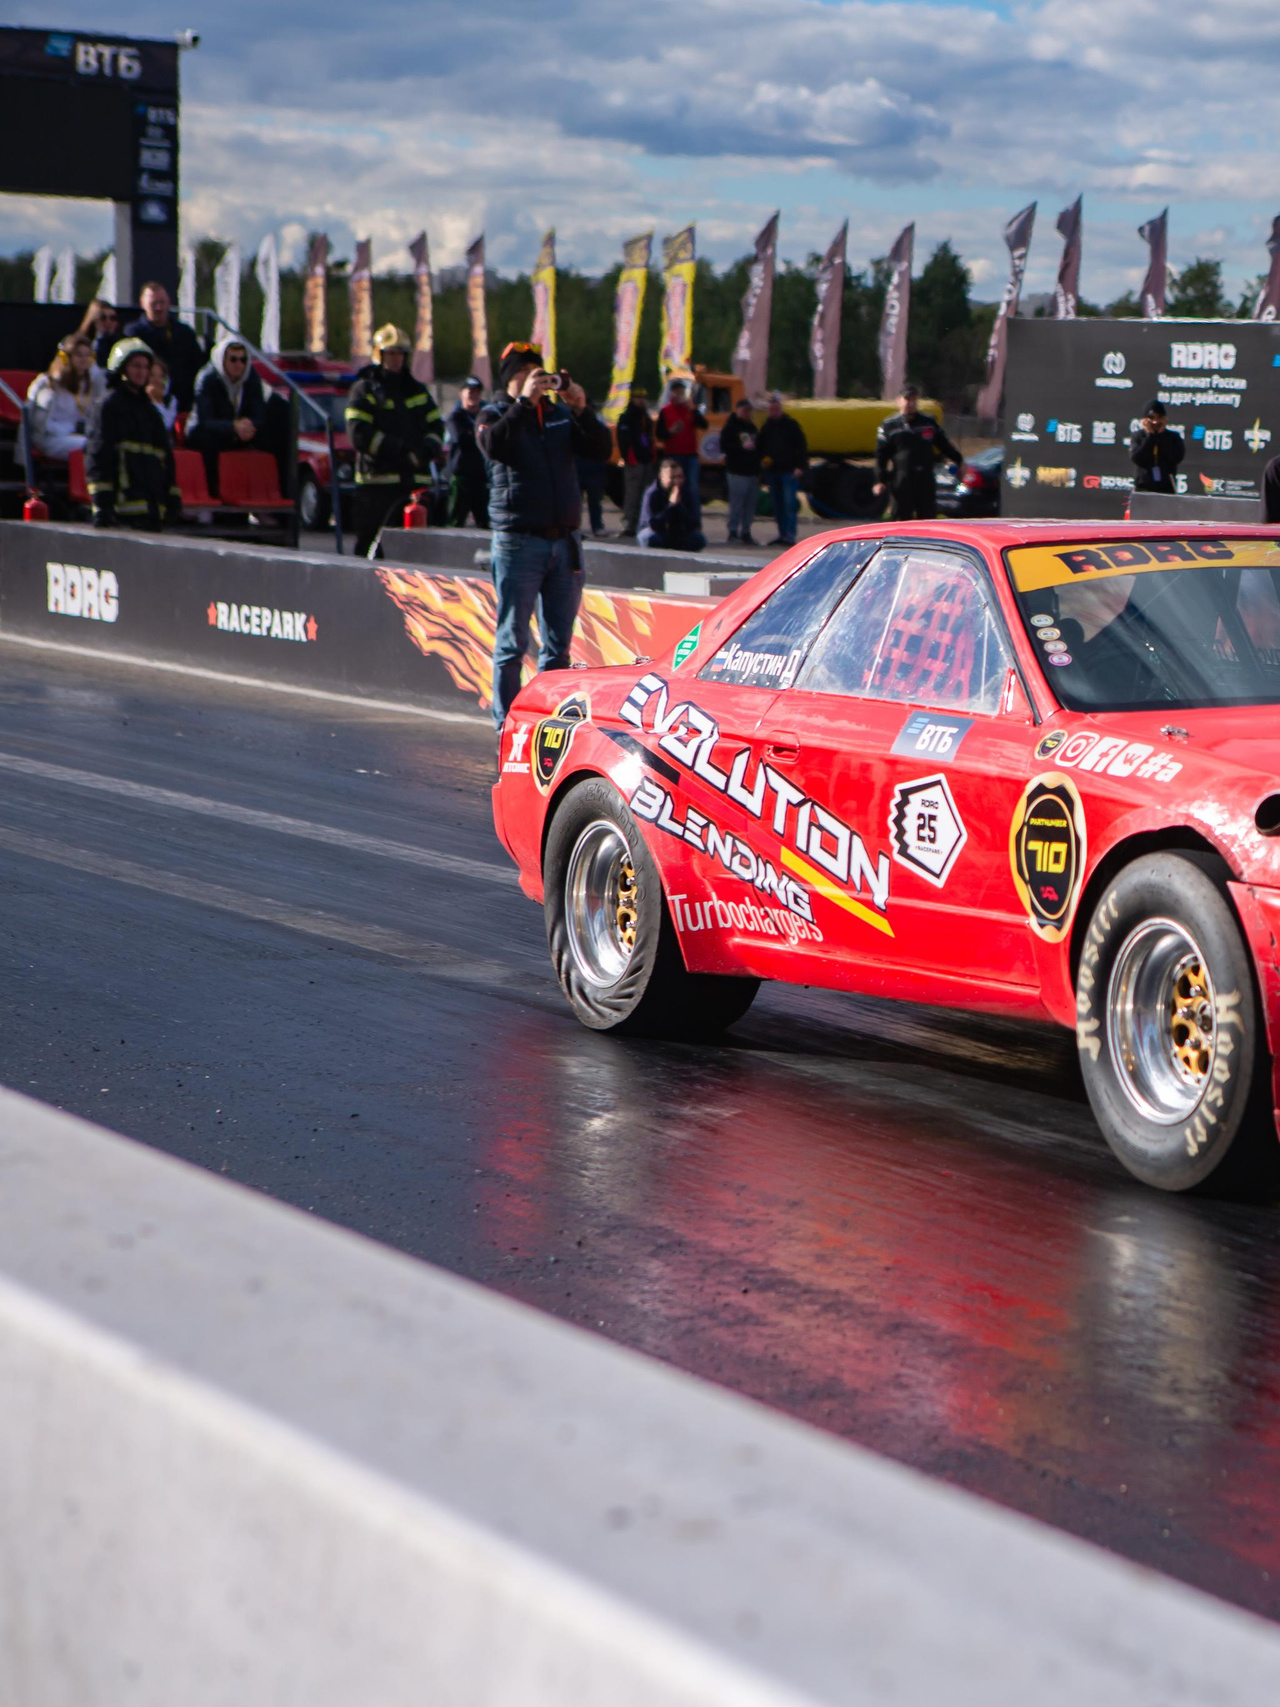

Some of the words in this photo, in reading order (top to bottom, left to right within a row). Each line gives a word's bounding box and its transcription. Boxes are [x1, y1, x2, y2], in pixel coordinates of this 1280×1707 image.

[75, 42, 143, 81] ВТБ
[1171, 343, 1237, 370] RDRC
[1157, 373, 1211, 388] Чемпионат
[1212, 374, 1247, 390] России
[1203, 430, 1233, 450] ВТБ
[1053, 541, 1235, 575] RDRC
[47, 562, 119, 622] RDRC
[216, 601, 308, 642] RACEPARK
[723, 643, 786, 680] Капустин
[543, 727, 565, 749] 710
[915, 724, 959, 754] ВТБ
[618, 672, 891, 912] EVOLUTION
[916, 812, 938, 845] 25
[1029, 817, 1068, 829] PARTNUMBER
[629, 775, 816, 924] BLENDING
[1027, 841, 1068, 873] 710
[667, 893, 824, 945] Turbochargers
